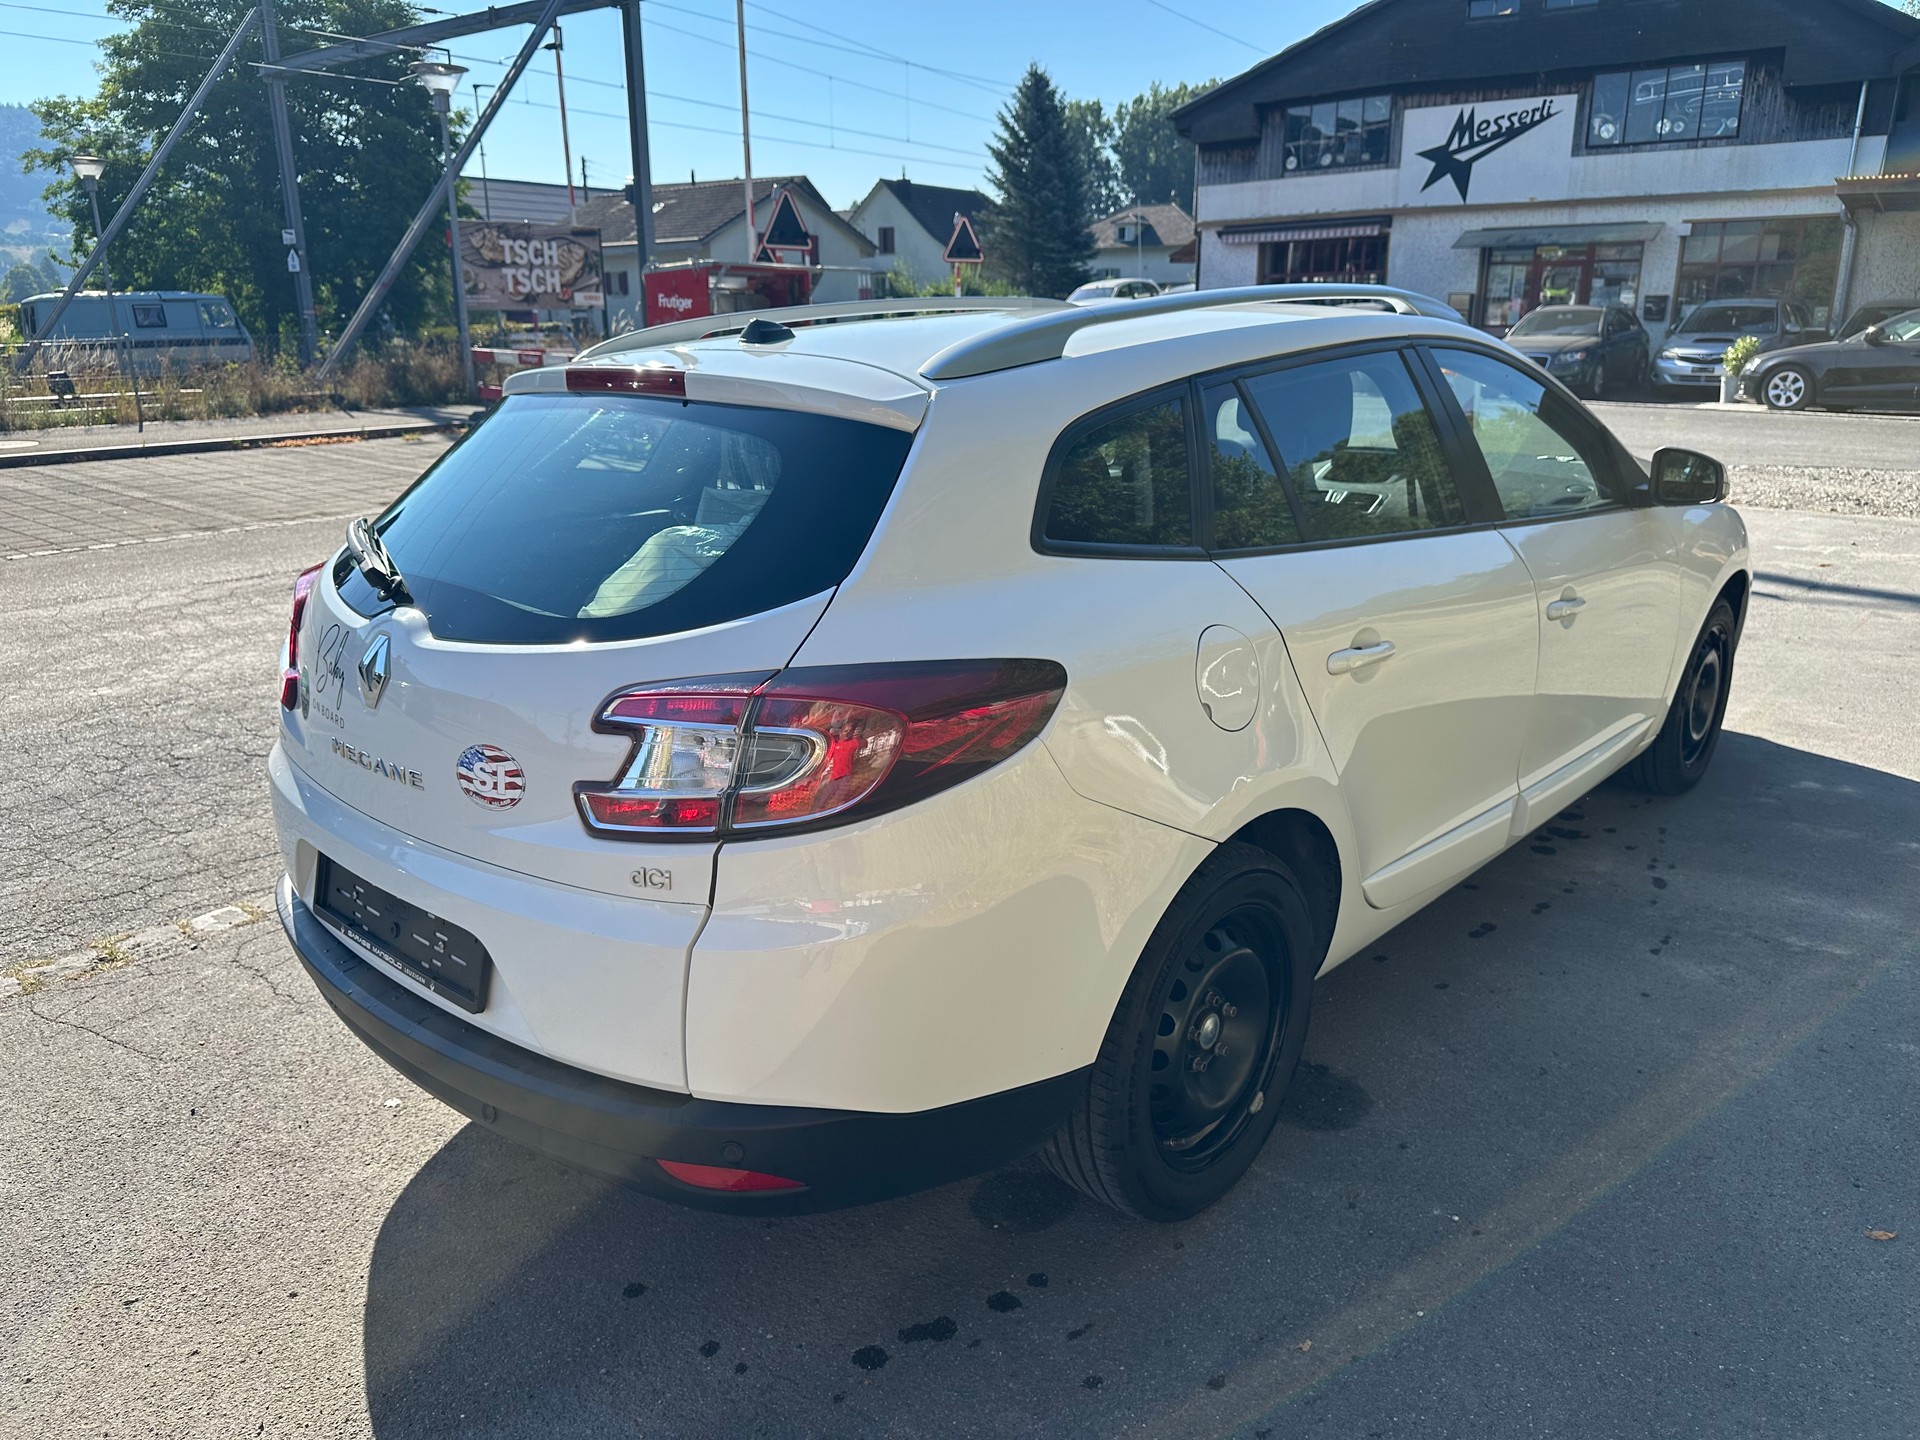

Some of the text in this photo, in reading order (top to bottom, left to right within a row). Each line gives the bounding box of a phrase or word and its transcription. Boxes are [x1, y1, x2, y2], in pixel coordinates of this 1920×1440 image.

[1446, 98, 1554, 149] Messerli
[500, 239, 558, 266] TSCH
[502, 267, 561, 293] TSCH
[657, 293, 693, 312] Frutiger
[316, 623, 349, 711] Baby
[331, 736, 424, 791] MEGANE
[473, 761, 506, 796] SI
[630, 866, 672, 891] dCi
